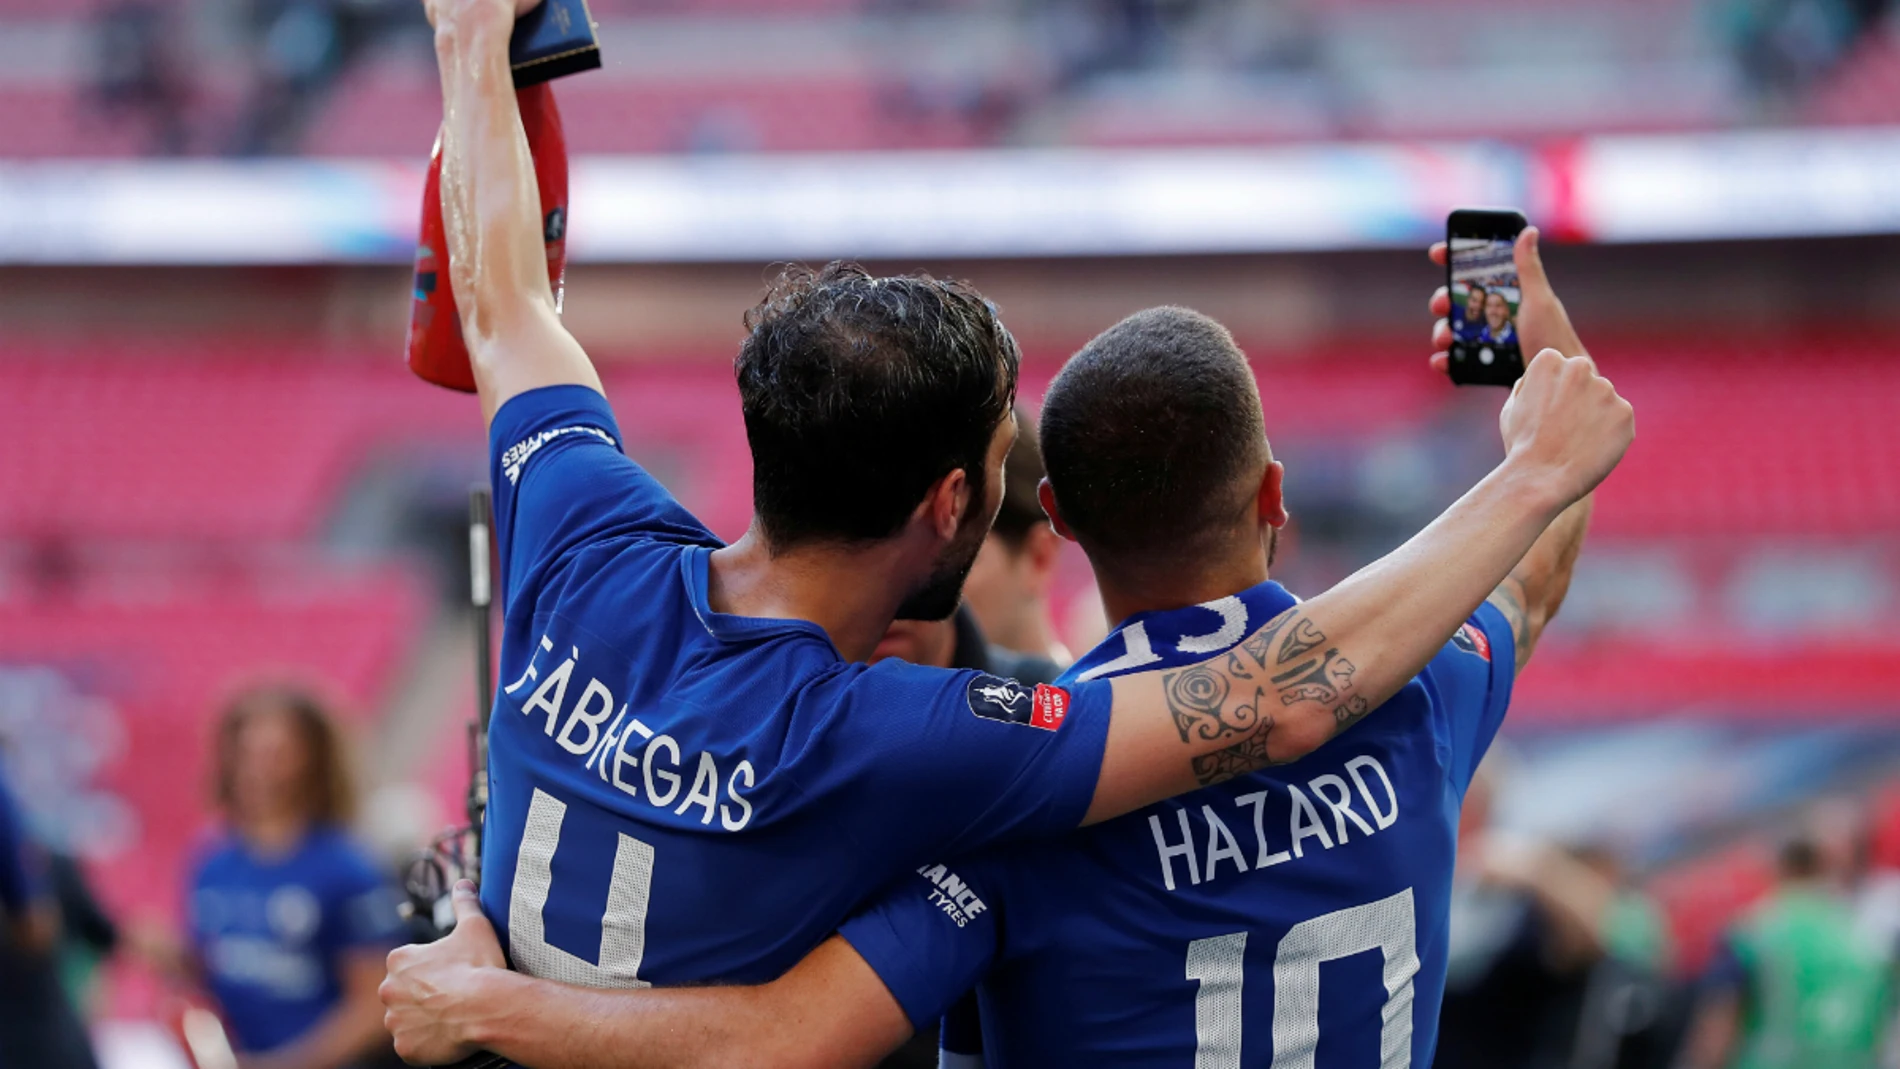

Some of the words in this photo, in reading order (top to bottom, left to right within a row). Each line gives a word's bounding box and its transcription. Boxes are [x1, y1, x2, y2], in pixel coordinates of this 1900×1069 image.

[508, 787, 655, 988] 4
[1148, 755, 1399, 890] HAZARD
[928, 888, 968, 928] TYRES
[1185, 886, 1421, 1069] 10
